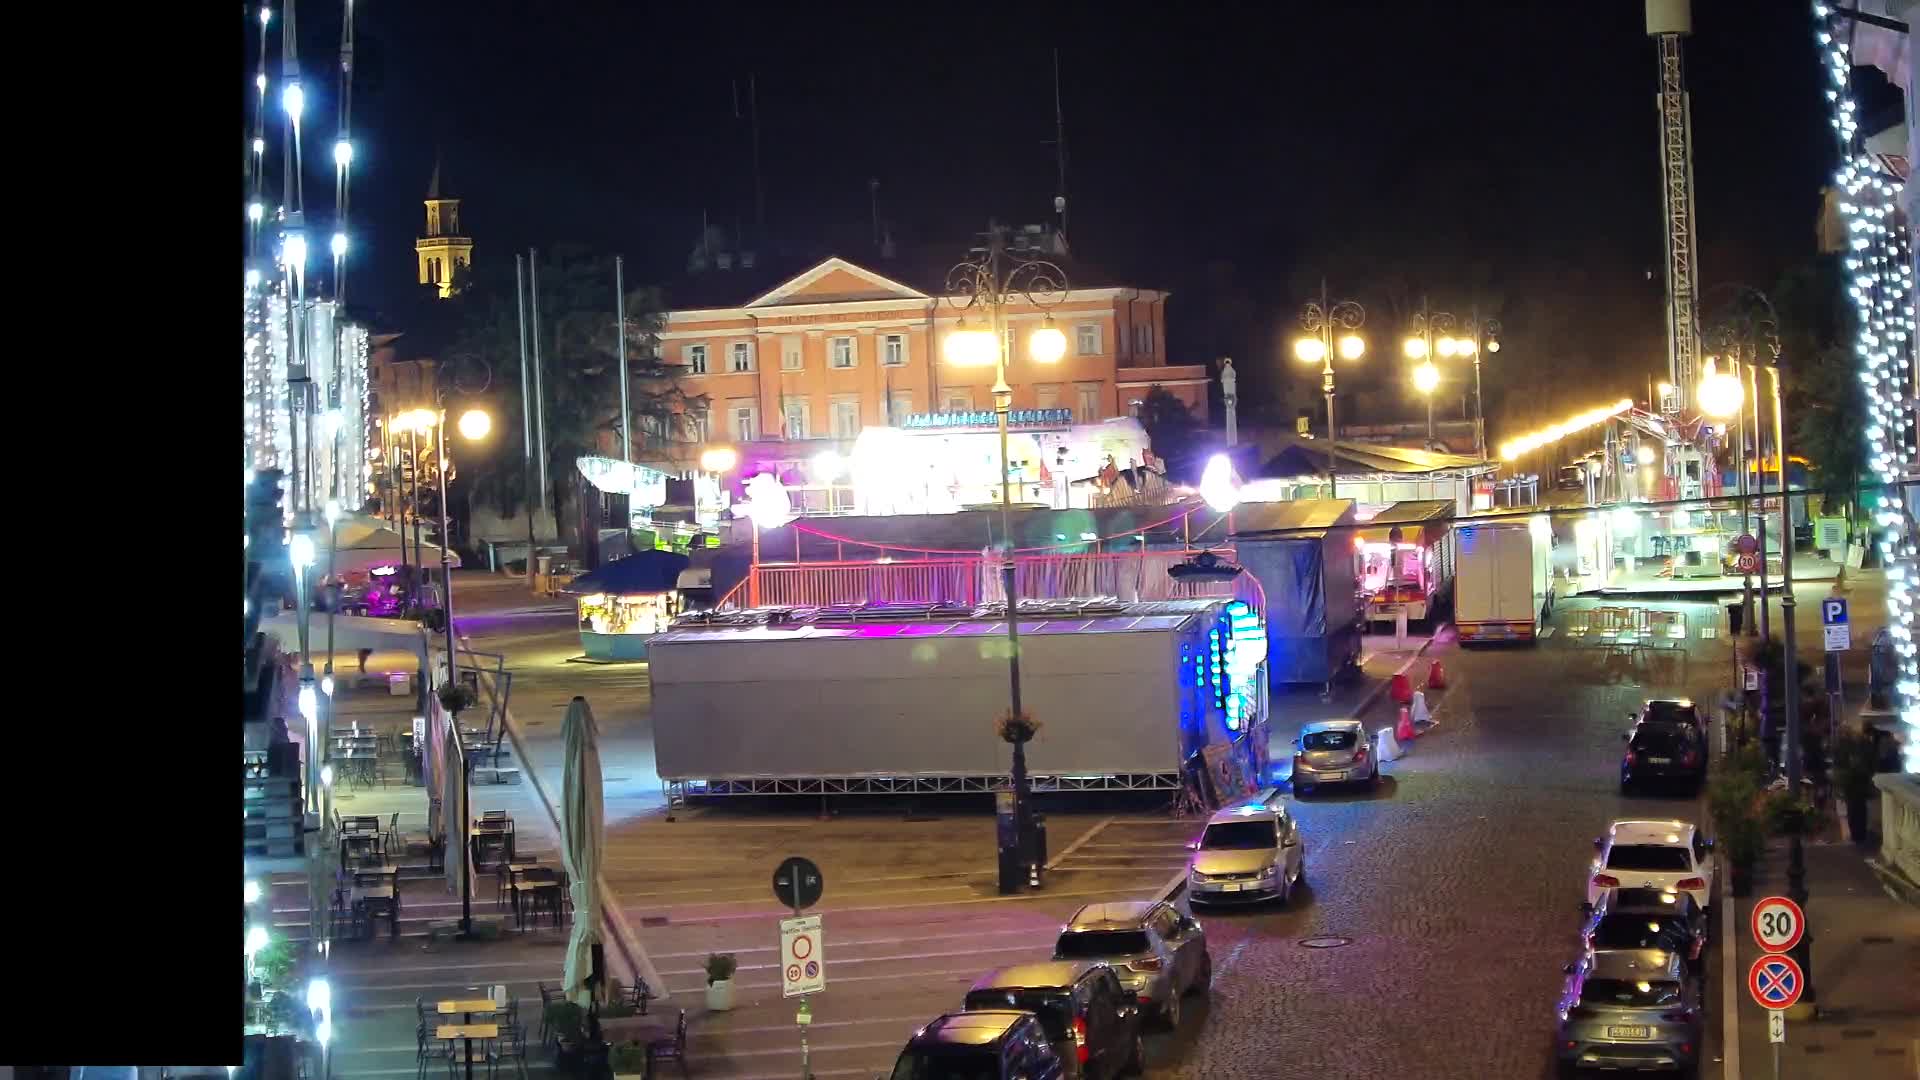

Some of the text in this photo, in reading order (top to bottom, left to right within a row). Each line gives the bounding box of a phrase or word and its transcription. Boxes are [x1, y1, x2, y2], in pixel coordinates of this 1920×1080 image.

[1743, 558, 1752, 567] 20
[1828, 602, 1842, 621] P
[1762, 912, 1791, 937] 30
